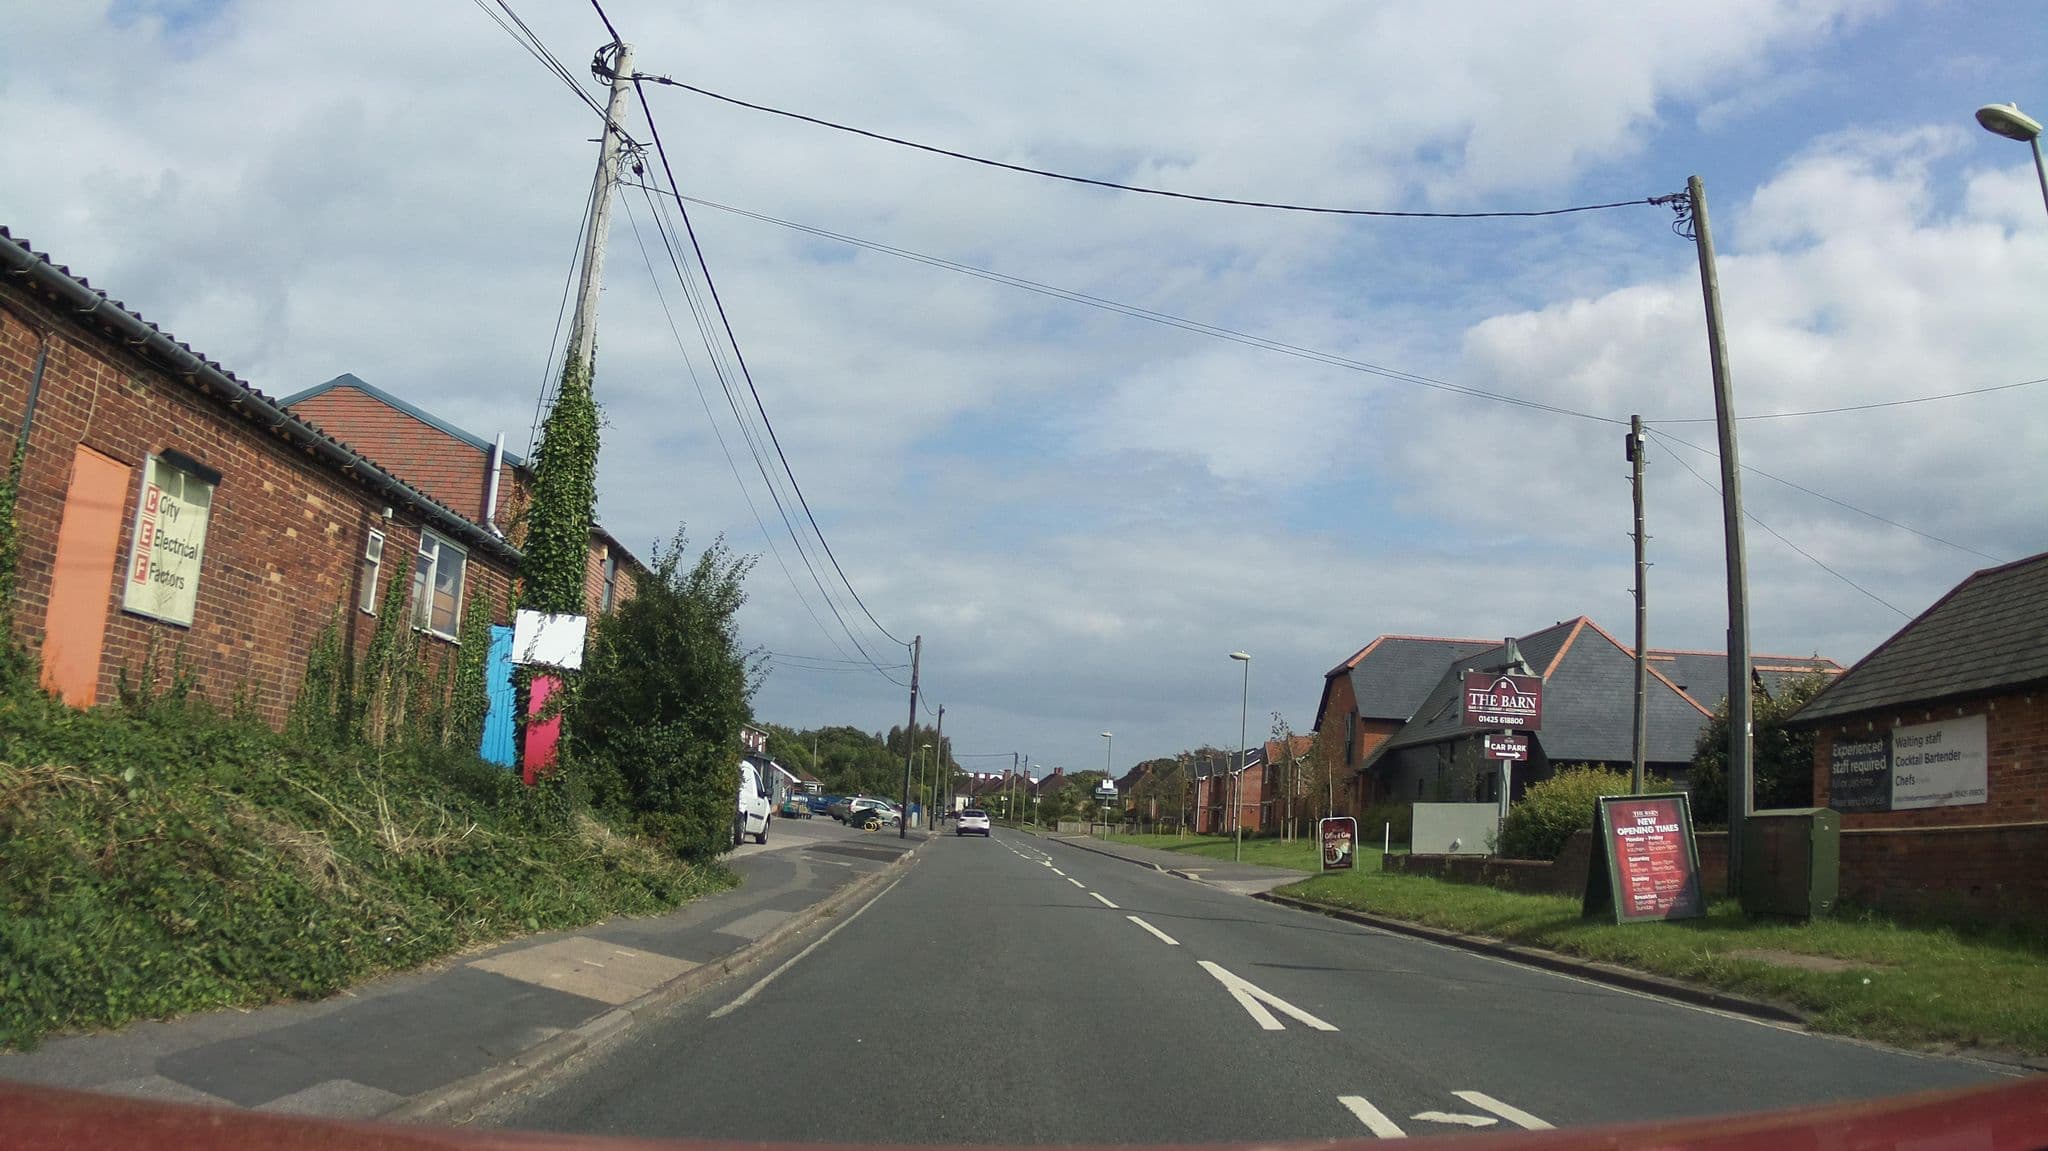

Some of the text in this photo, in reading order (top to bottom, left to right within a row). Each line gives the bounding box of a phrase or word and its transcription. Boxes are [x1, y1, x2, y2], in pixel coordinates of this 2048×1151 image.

[159, 495, 181, 523] City
[154, 529, 199, 561] Electrical
[149, 562, 185, 590] Factors
[1469, 693, 1537, 709] THE BARN
[1478, 715, 1499, 723] 01425
[1490, 743, 1527, 752] CAR PARK
[1895, 730, 1942, 748] Waiting staff
[1832, 739, 1883, 759] Experienced
[1832, 755, 1887, 774] staff required
[1895, 754, 1923, 767] Cocktail
[1924, 750, 1961, 764] Bartender
[1895, 774, 1915, 787] Chefs
[1617, 824, 1679, 836] OPENING TIMES
[1637, 817, 1657, 826] NEW
